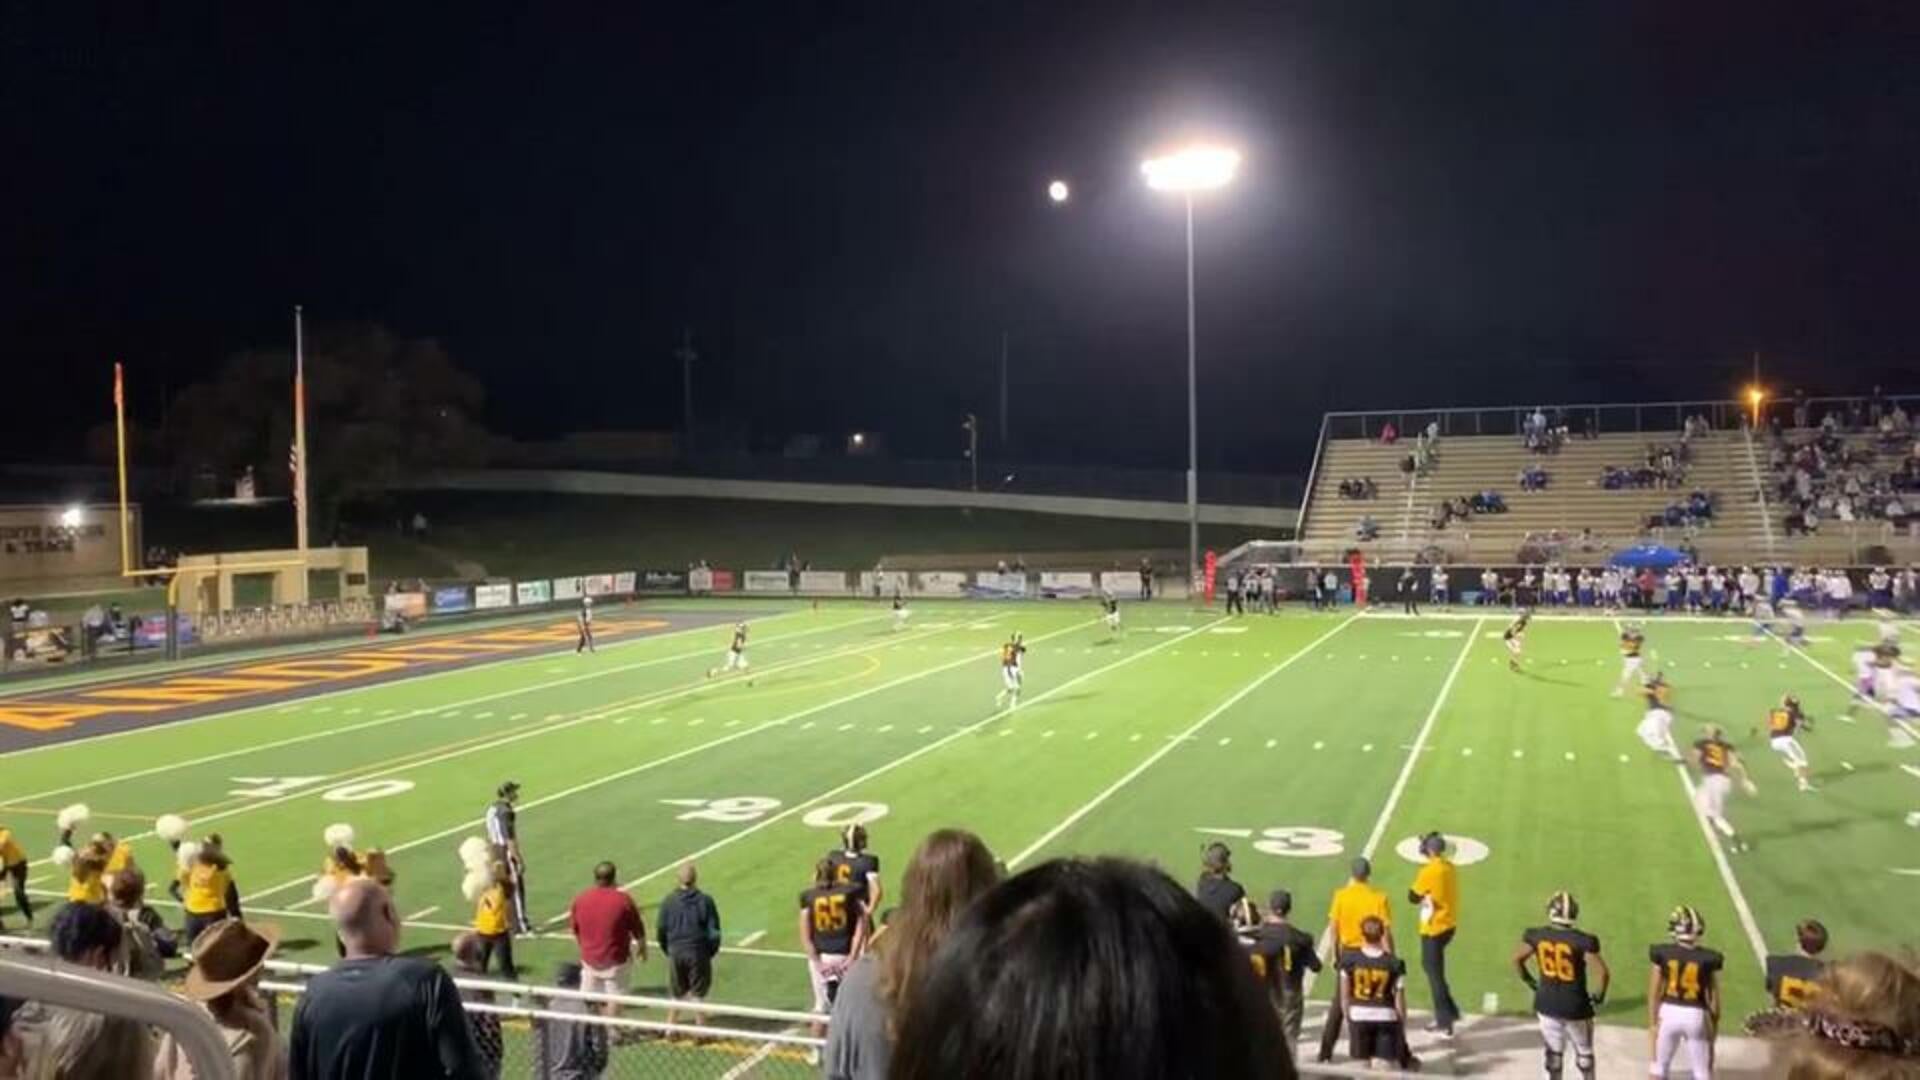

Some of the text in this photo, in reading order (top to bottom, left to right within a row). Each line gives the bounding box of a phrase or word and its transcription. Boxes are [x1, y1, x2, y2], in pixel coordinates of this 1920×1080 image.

[813, 894, 848, 932] 65
[1536, 940, 1575, 982] 66
[1666, 959, 1700, 999] 14
[1353, 967, 1389, 1001] 87
